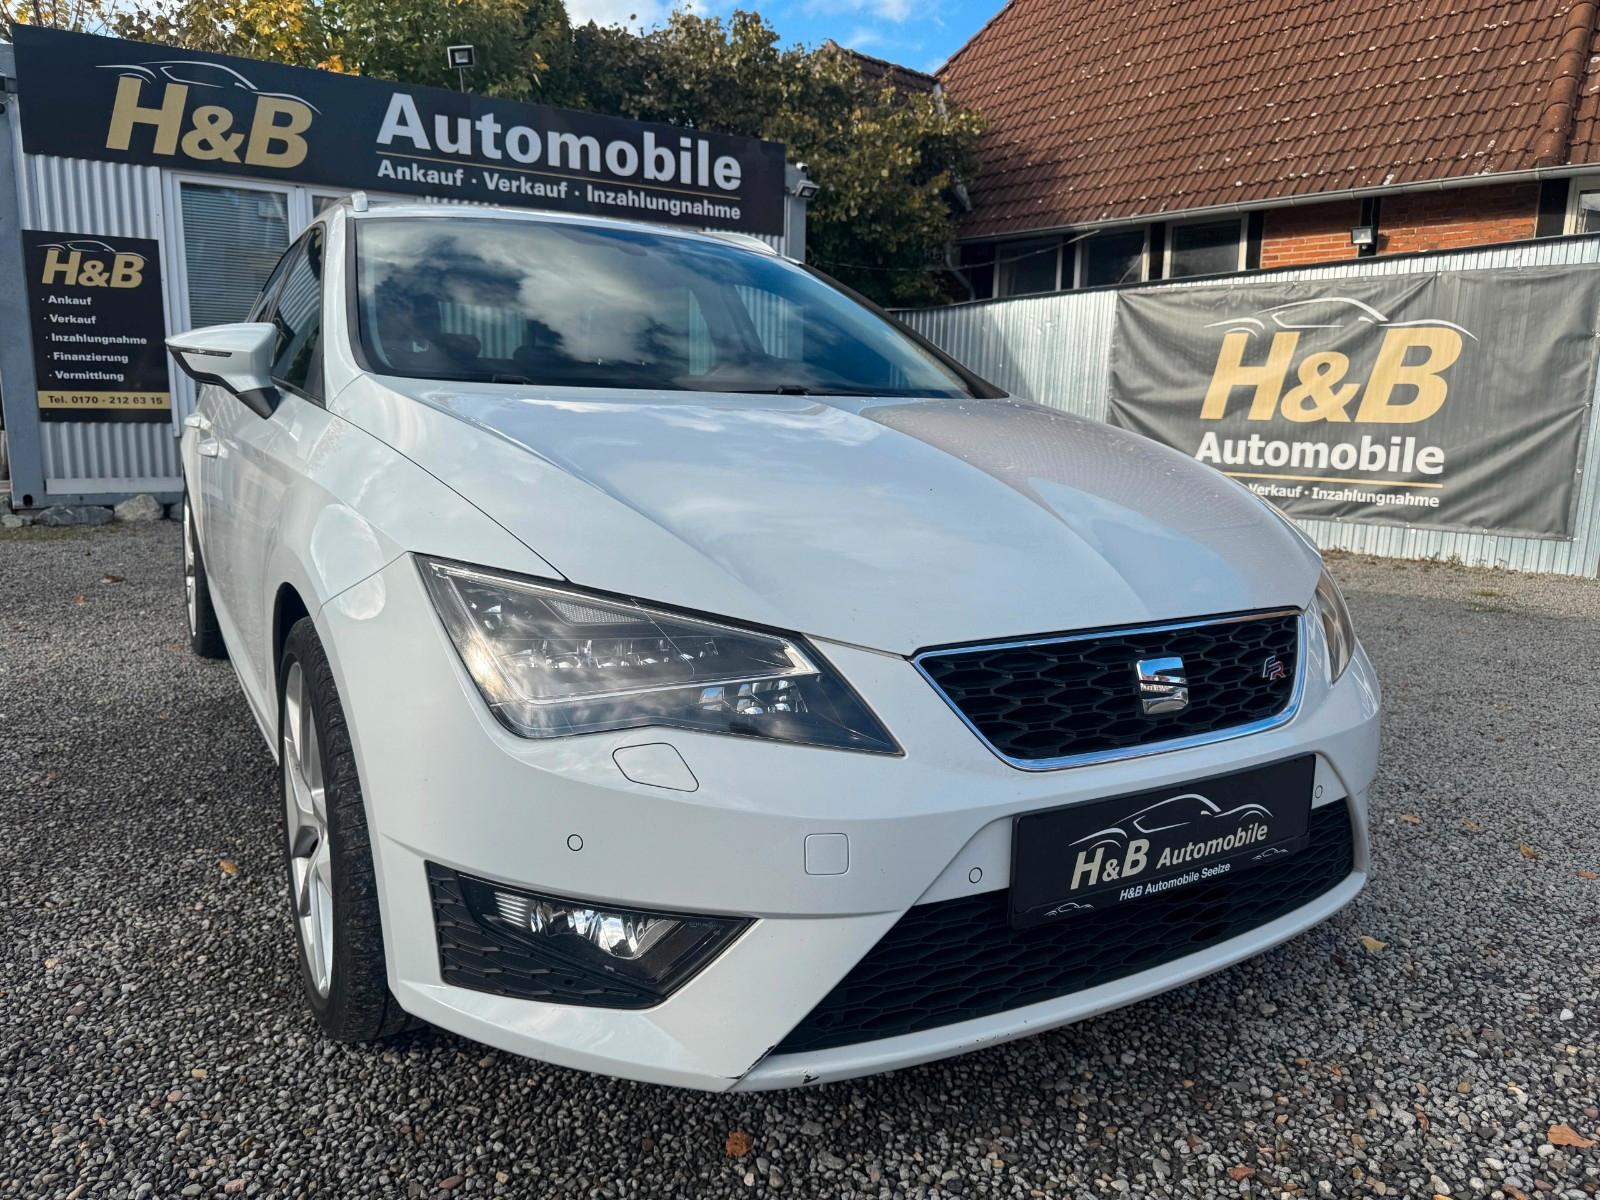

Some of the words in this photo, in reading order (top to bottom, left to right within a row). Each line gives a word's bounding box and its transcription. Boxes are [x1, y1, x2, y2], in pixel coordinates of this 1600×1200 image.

[105, 74, 313, 169] H&B
[376, 92, 742, 191] Automobile
[377, 159, 464, 187] Ankauf
[483, 171, 568, 200] Verkauf
[587, 184, 741, 220] Inzahlungnahme
[42, 250, 145, 288] H&B
[48, 295, 92, 305] Ankauf
[49, 314, 97, 325] Verkauf
[51, 333, 147, 345] Inzahlungnahme
[53, 352, 129, 364] Finanzierung
[55, 371, 125, 382] Vermittlung
[1200, 327, 1463, 424] H&B
[48, 395, 68, 404] Tel.
[71, 396, 99, 404] 0170
[109, 396, 129, 405] 212
[151, 397, 163, 405] 15
[1195, 431, 1446, 476] Automobile
[1249, 483, 1303, 498] Verkauf
[1311, 487, 1440, 508] Inzahlungnahme
[1263, 655, 1286, 681] FR
[1070, 838, 1150, 890] H&B
[1156, 822, 1269, 869] Automobile
[1119, 886, 1143, 901] H&B
[1144, 871, 1200, 895] Automobile
[1200, 862, 1231, 879] Seelze
